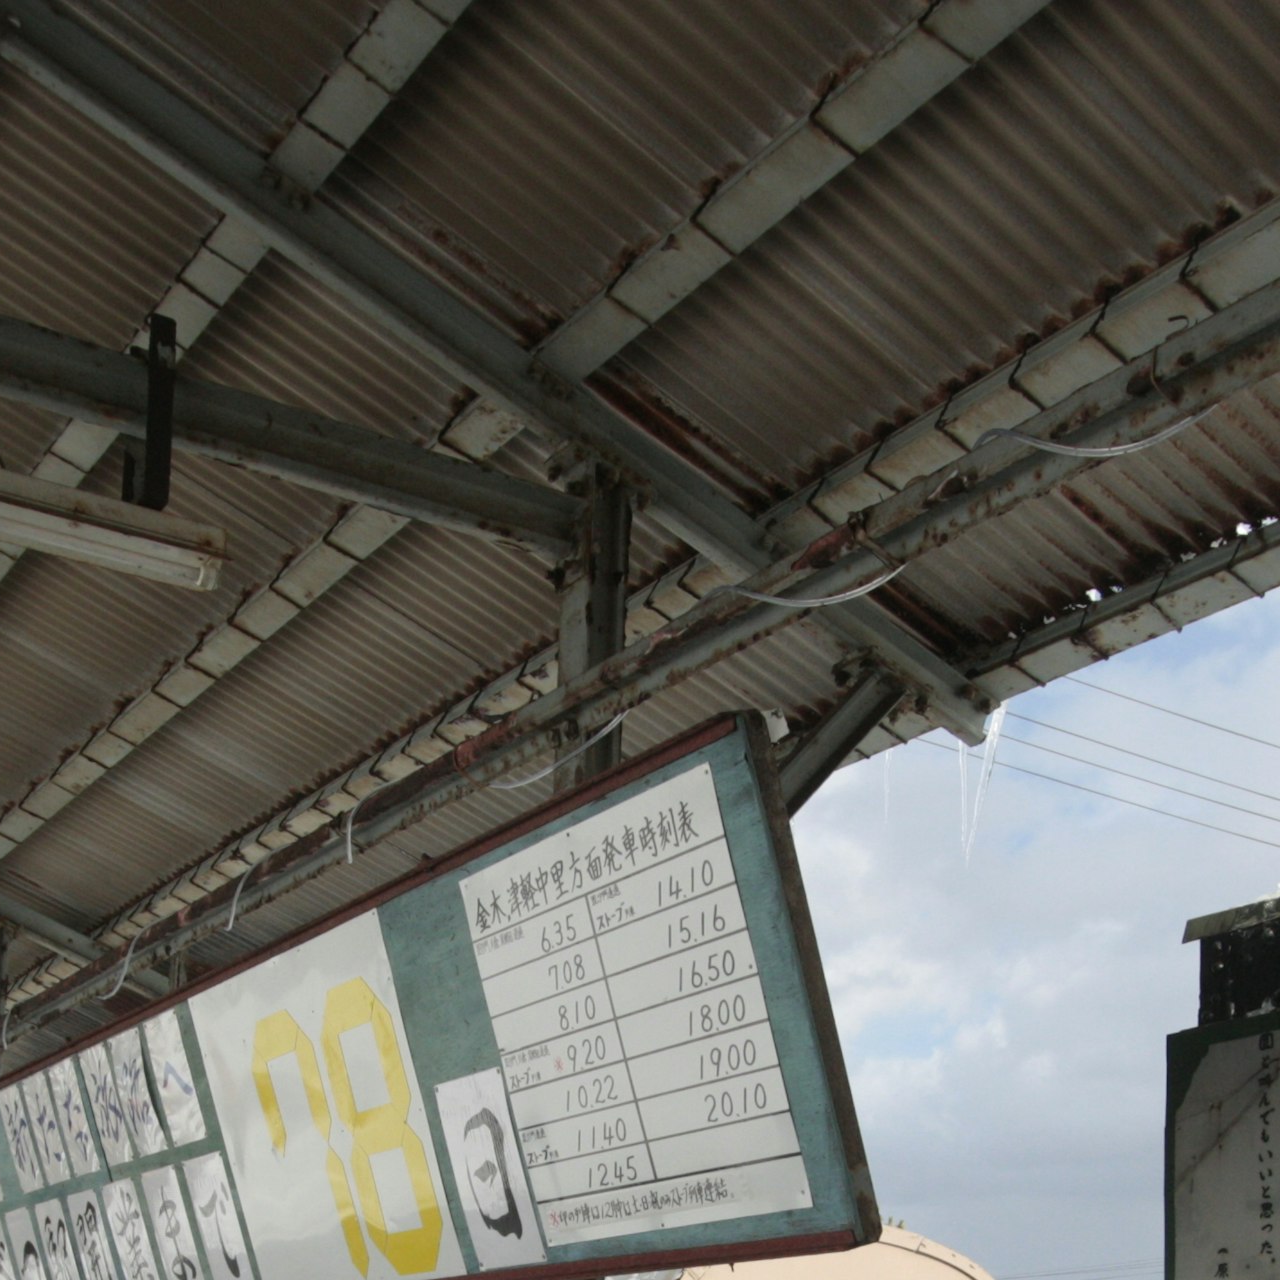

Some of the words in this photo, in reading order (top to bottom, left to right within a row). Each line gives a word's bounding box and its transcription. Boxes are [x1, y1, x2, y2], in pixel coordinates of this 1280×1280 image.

[658, 860, 713, 907] 14.10
[541, 914, 577, 954] 6.35
[667, 904, 726, 949] 15.16
[548, 953, 586, 991] 7.08
[678, 949, 736, 992] 16.50
[558, 995, 597, 1031] 8.10
[688, 994, 747, 1036] 18.00
[567, 1035, 606, 1073] 9.20
[699, 1039, 758, 1081] 19.00
[566, 1075, 618, 1113] 10.22
[704, 1083, 768, 1123] 20.10
[577, 1118, 628, 1152] 11.40
[588, 1155, 638, 1189] 12.45
